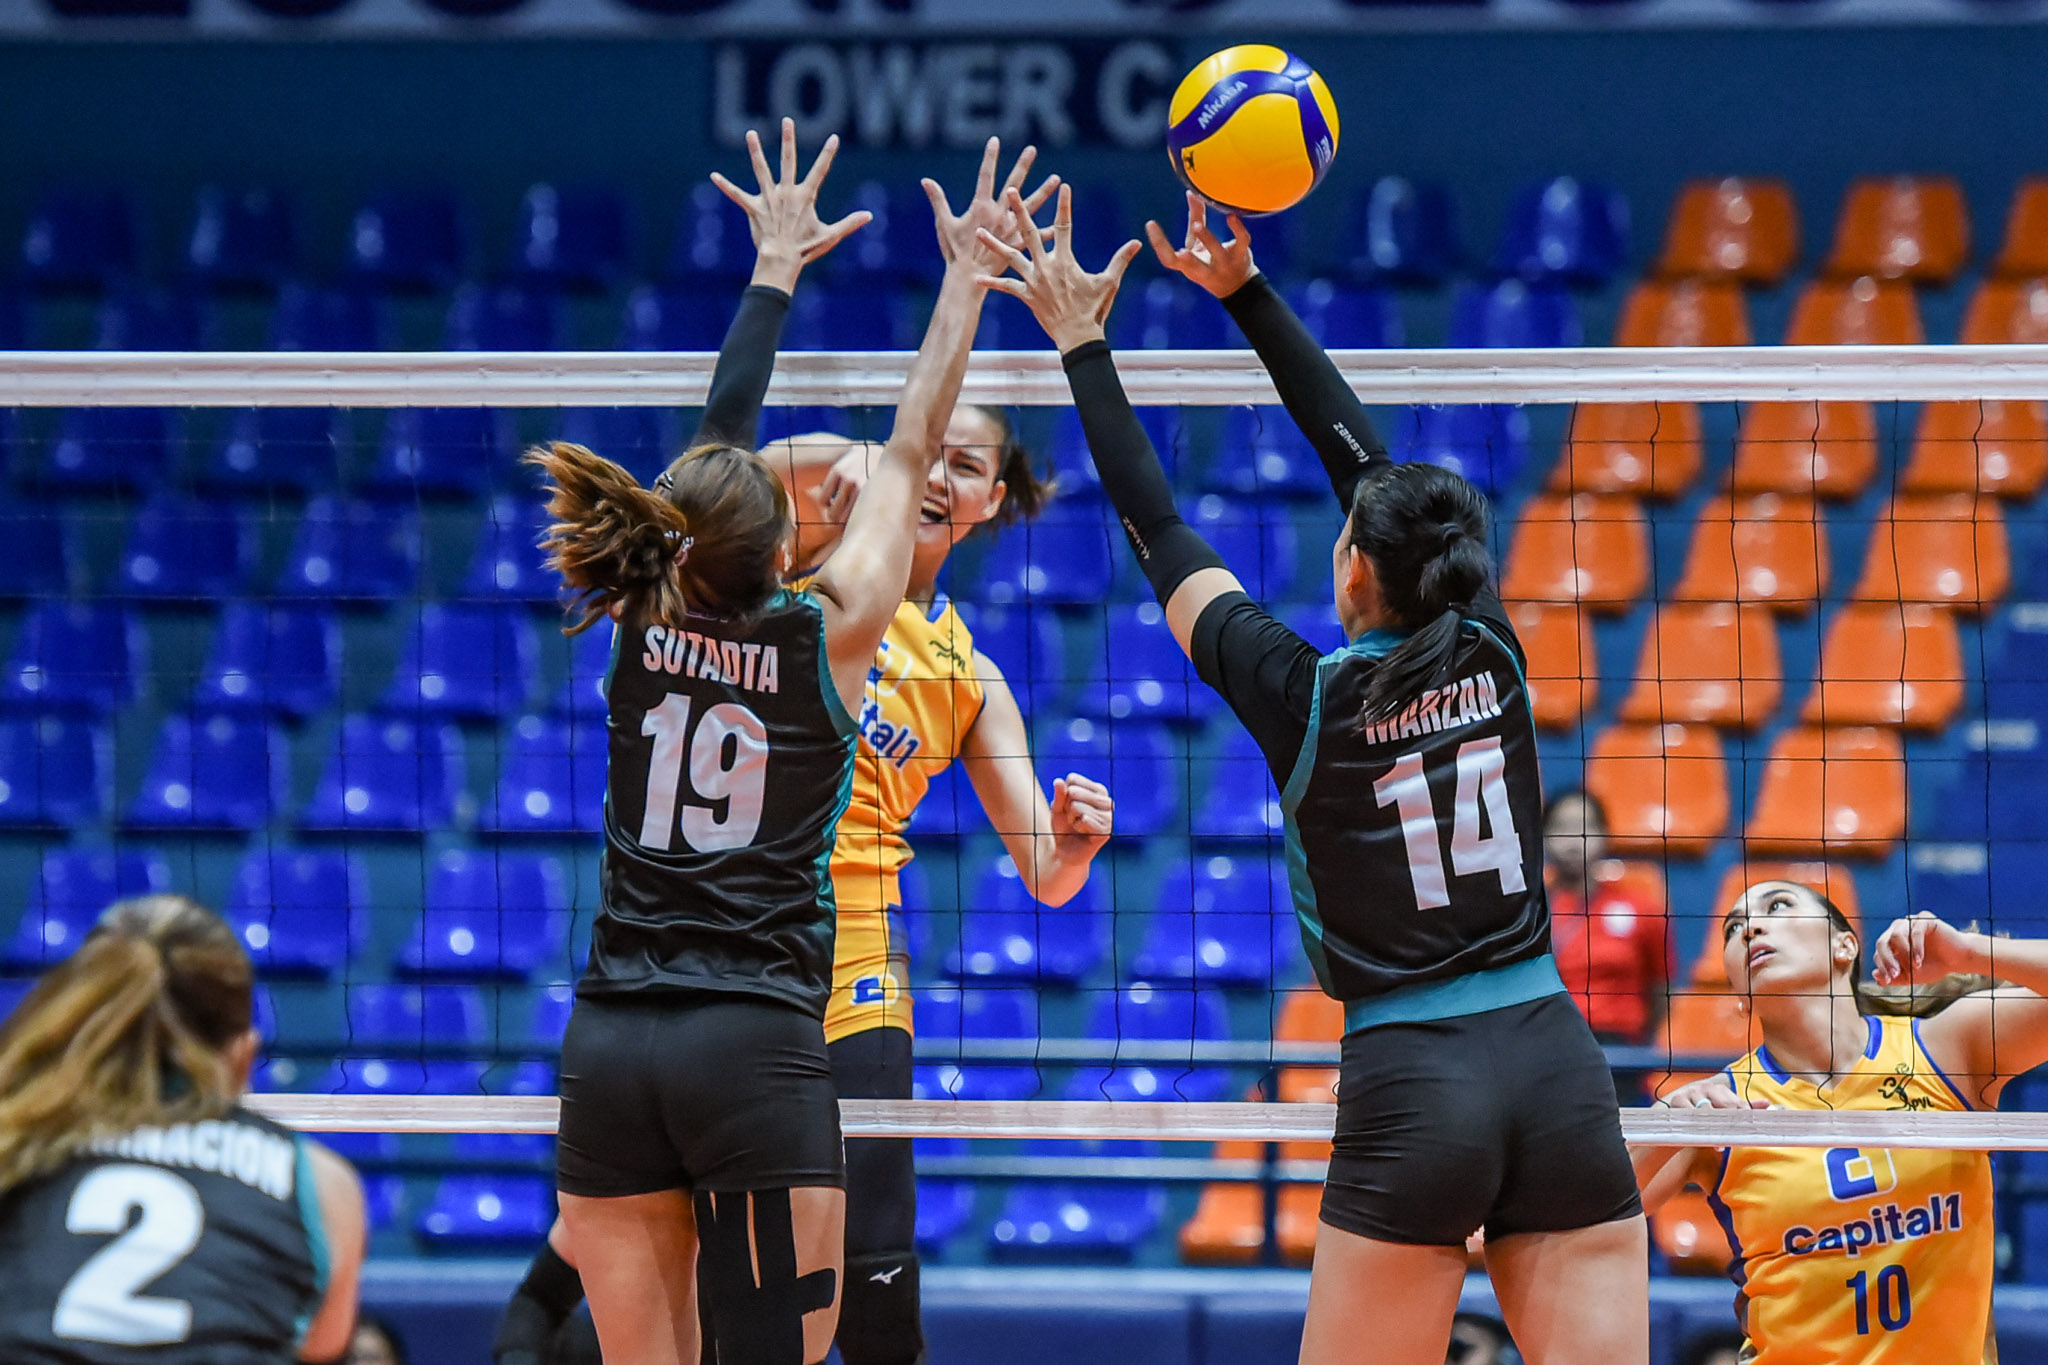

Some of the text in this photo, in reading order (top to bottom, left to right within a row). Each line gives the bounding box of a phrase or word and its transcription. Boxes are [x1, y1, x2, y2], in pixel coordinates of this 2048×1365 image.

[714, 40, 1171, 148] LOWER C
[1197, 80, 1248, 130] MIKASA
[643, 624, 778, 693] SUTADTA
[638, 692, 769, 853] 19
[1372, 735, 1528, 911] 14
[52, 1162, 204, 1346] 2
[1784, 1193, 1962, 1257] Capital1
[1846, 1264, 1911, 1335] 10
